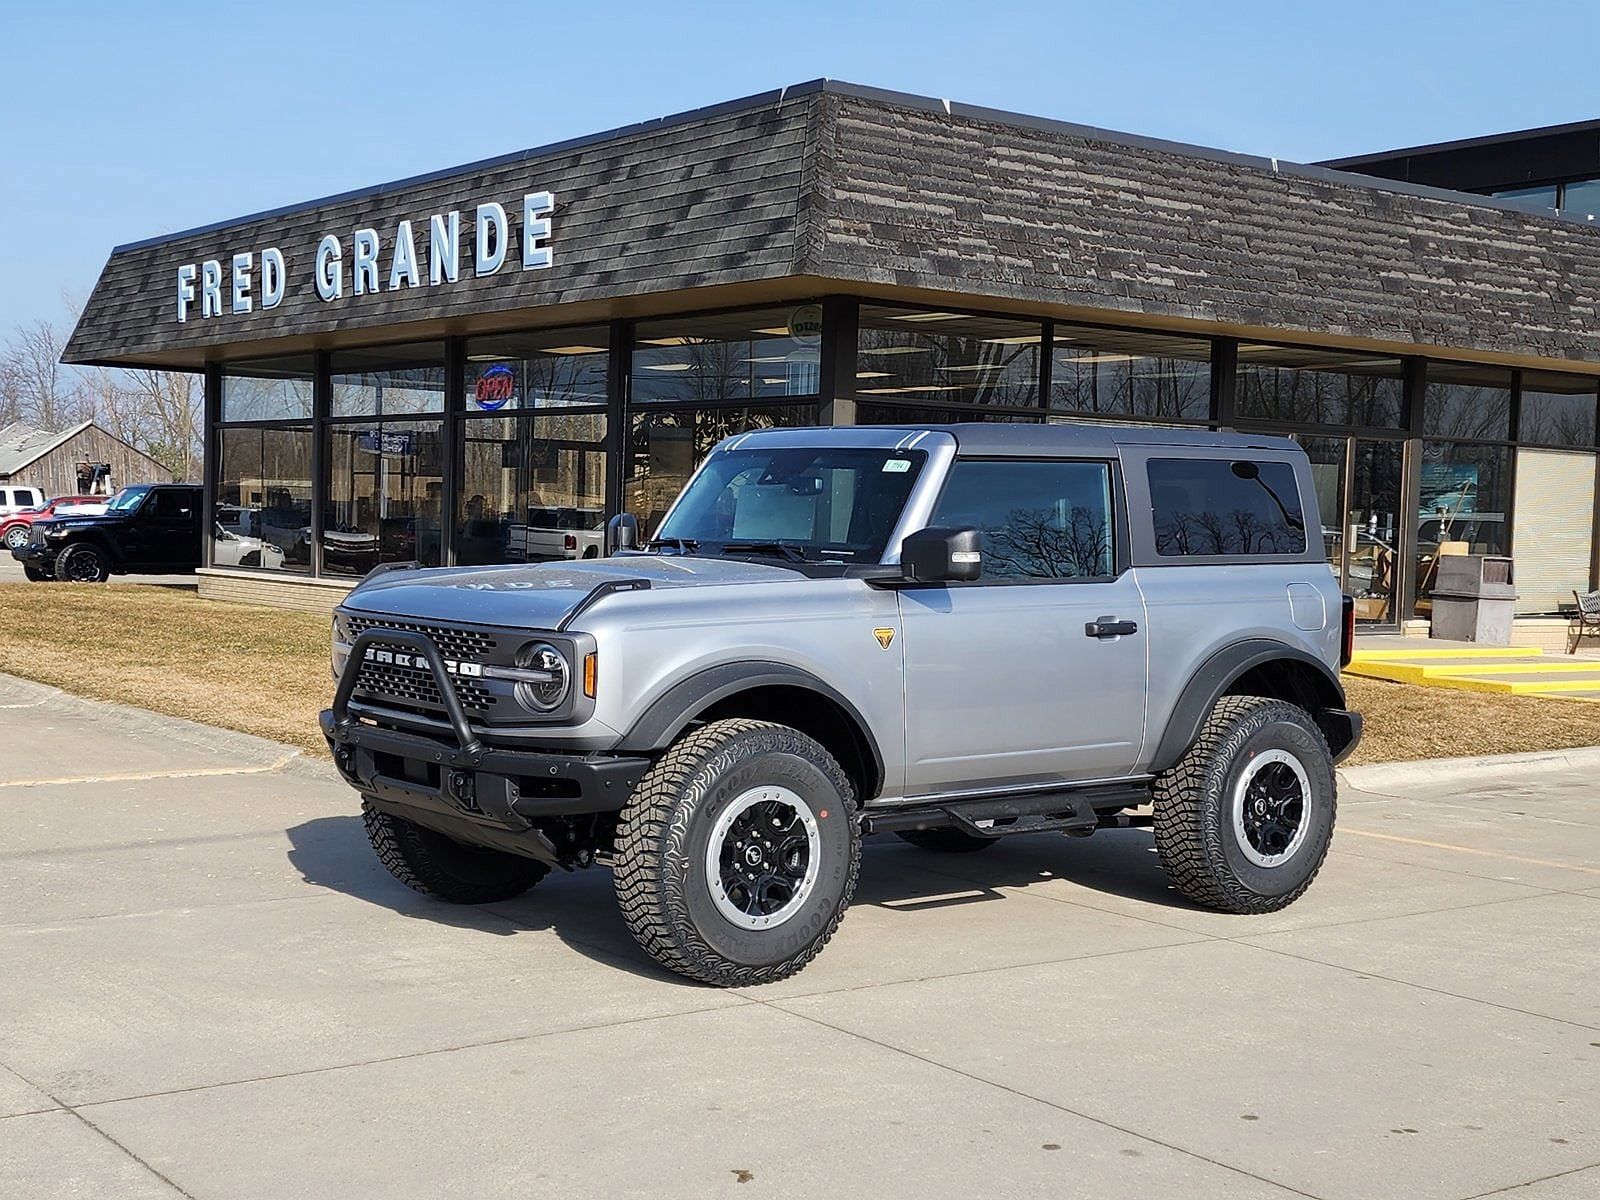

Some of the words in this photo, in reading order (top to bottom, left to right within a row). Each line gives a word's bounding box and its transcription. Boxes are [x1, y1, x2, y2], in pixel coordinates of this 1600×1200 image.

[177, 247, 286, 323] FRED
[315, 190, 556, 303] GRANDE
[475, 375, 514, 400] OPEN
